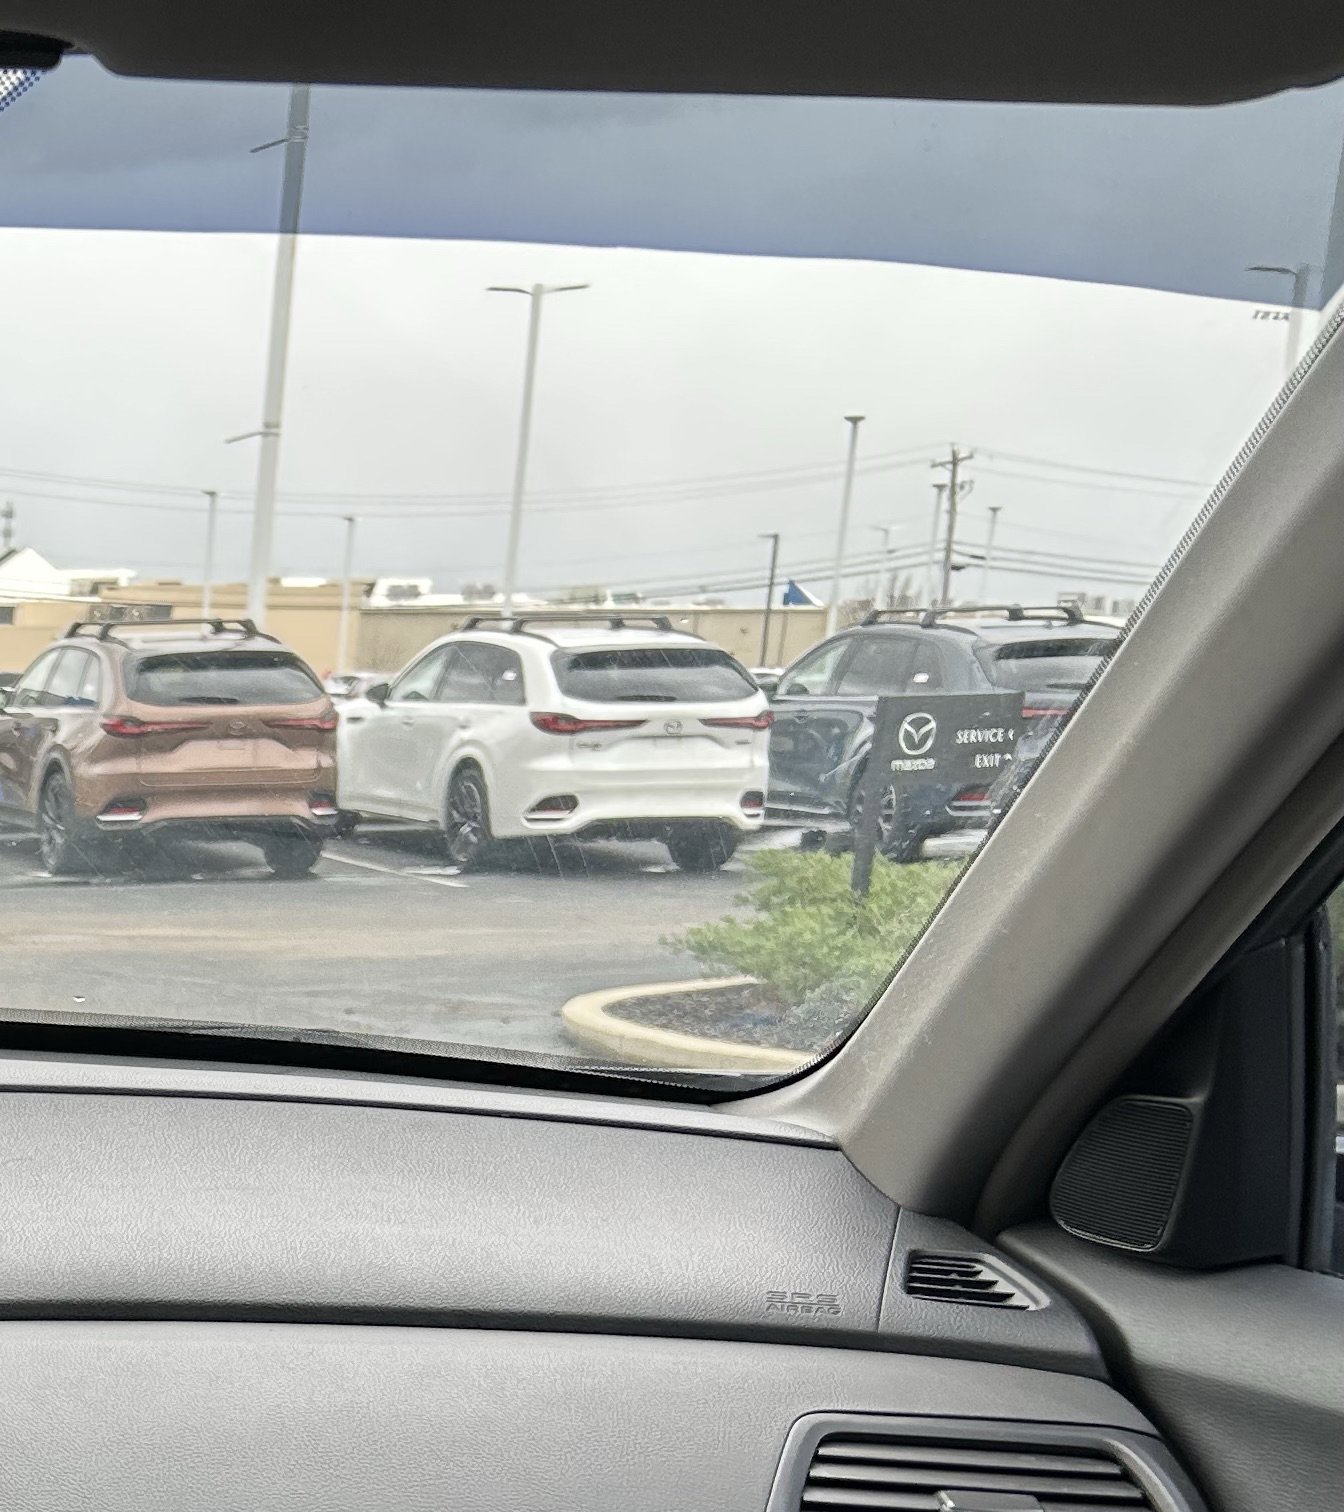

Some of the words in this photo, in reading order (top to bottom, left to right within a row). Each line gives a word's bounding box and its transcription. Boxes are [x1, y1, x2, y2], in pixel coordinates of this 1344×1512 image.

[955, 727, 1005, 745] SERVICE
[974, 753, 1002, 769] EXIT
[765, 1303, 842, 1315] AIRBAG
